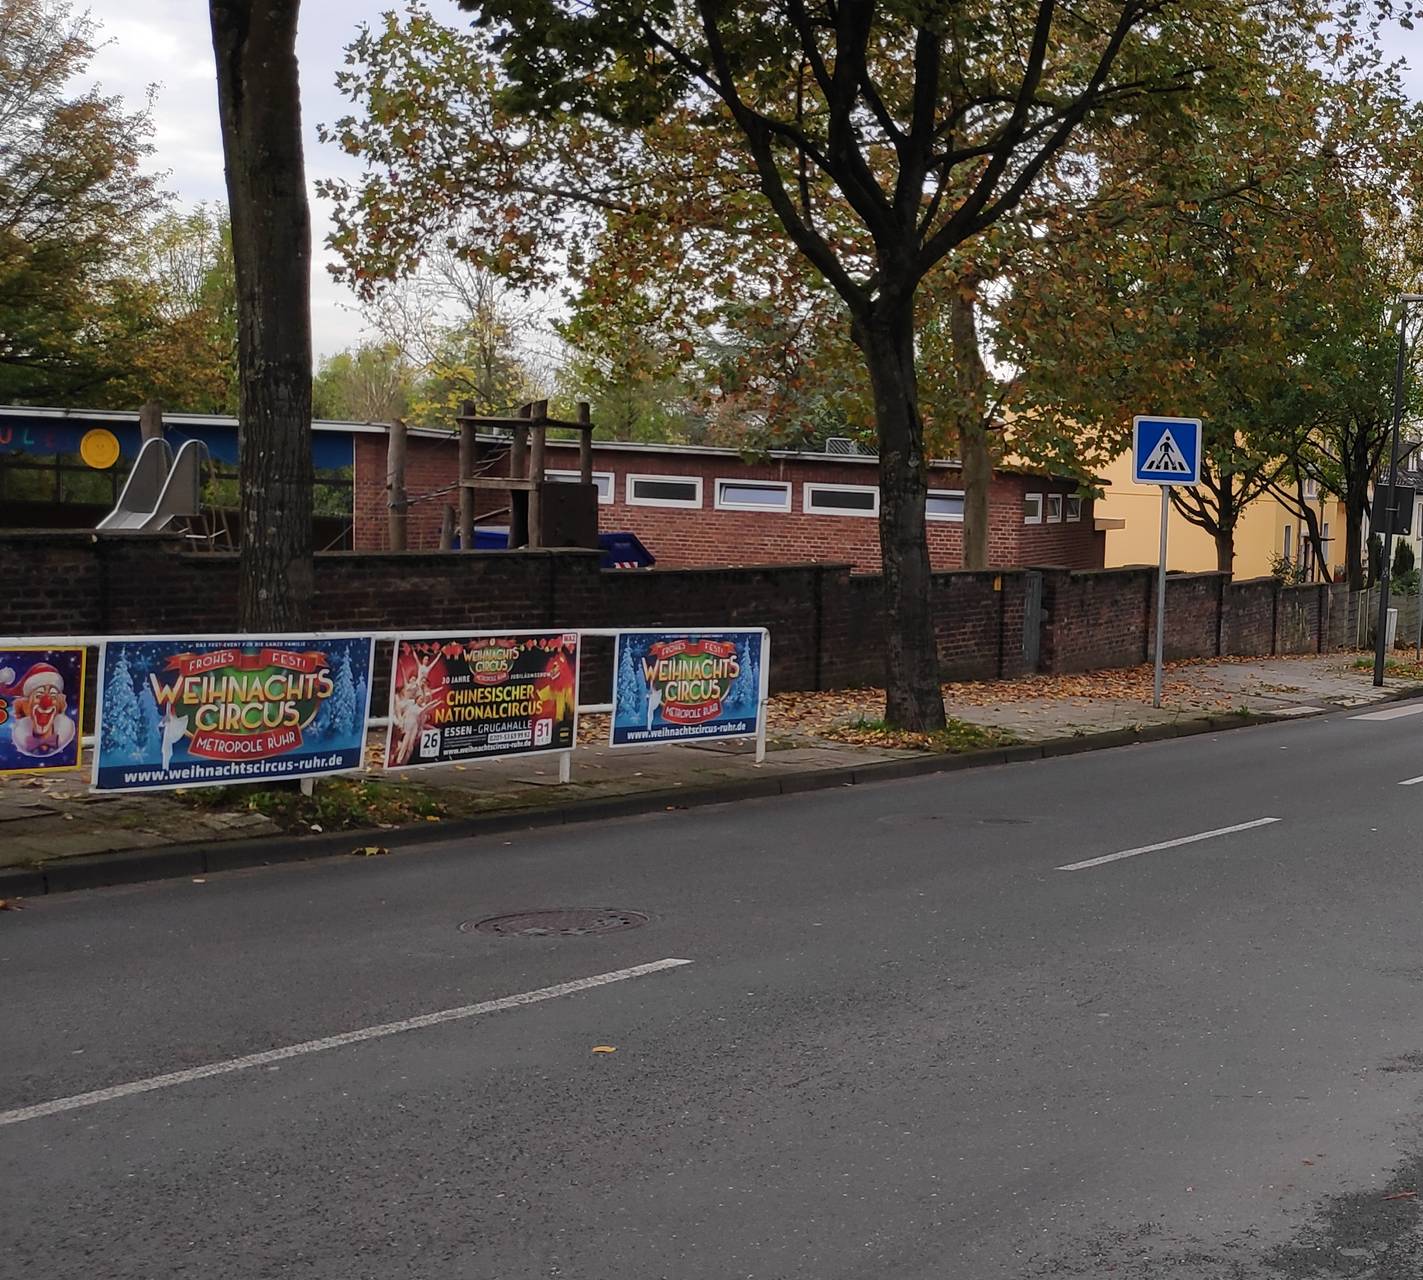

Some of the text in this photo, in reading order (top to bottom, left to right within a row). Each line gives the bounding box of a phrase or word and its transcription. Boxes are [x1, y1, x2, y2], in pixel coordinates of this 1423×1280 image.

[189, 652, 306, 672] FROHES FEST!
[463, 646, 519, 661] WEIHNACHTS
[475, 660, 508, 672] CIRCUS
[642, 655, 740, 680] WEIHNACHTS
[150, 668, 335, 705] WEIHNACHTS
[442, 676, 450, 684] 30
[451, 675, 470, 684] JAHRE
[446, 684, 534, 706] CHINESISCHER
[665, 680, 721, 701] CIRCUS
[195, 700, 300, 731] CIRCUS
[435, 700, 543, 723] NATIONALCIRCUS
[423, 733, 438, 748] 26
[537, 722, 549, 738] 31
[627, 722, 746, 740] www.weihnachtscircus-ruhr.de
[196, 731, 296, 753] METROPOLE RUHR
[124, 753, 343, 784] www.weihnachtscircus-ruhr.de
